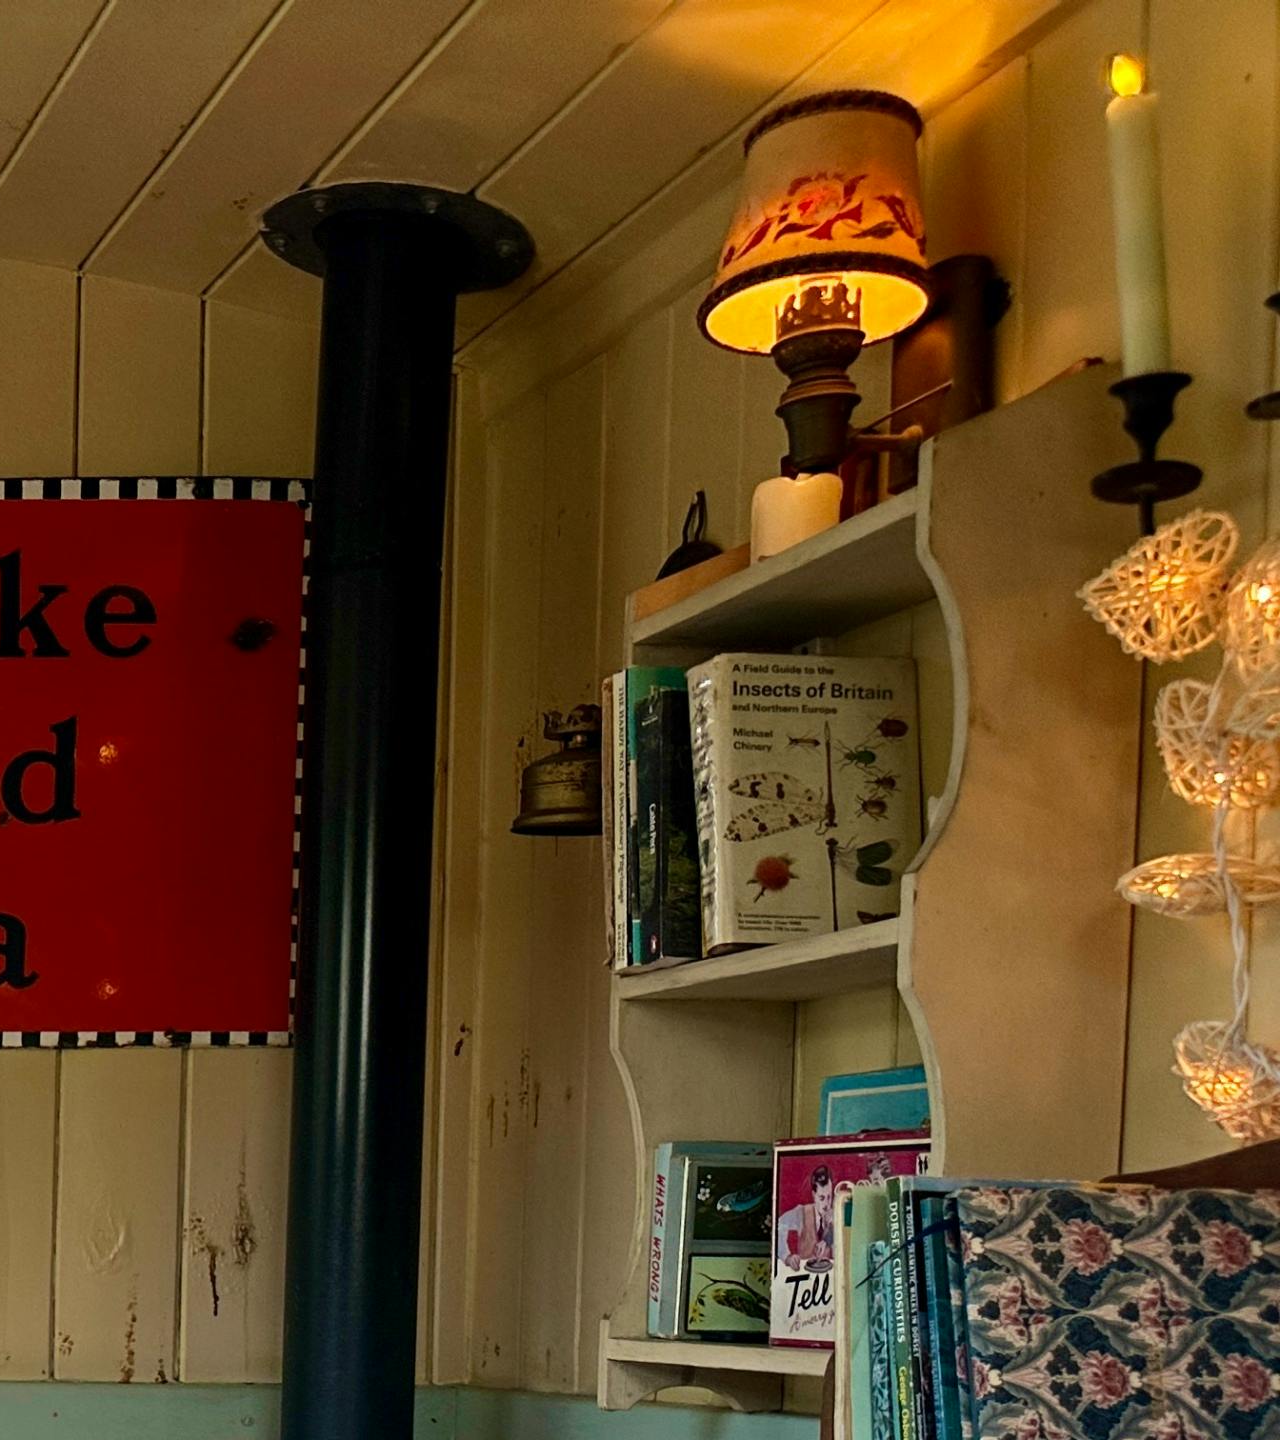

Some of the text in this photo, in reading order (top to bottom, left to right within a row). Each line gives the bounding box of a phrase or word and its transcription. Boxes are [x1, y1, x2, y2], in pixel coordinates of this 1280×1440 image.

[732, 663, 835, 676] A Field Guide to the
[732, 680, 894, 701] Insects of Britain
[732, 703, 838, 716] and Northern Europe
[732, 727, 774, 738] Michael
[732, 740, 773, 753] Chinery
[650, 1174, 666, 1304] WHATS WRONG?
[889, 1201, 907, 1344] DORSET CURIOSITIES
[784, 1273, 833, 1318] Tell
[910, 1286, 918, 1314] WALKS
[912, 1327, 920, 1358] DORSET
[898, 1365, 909, 1407] George
